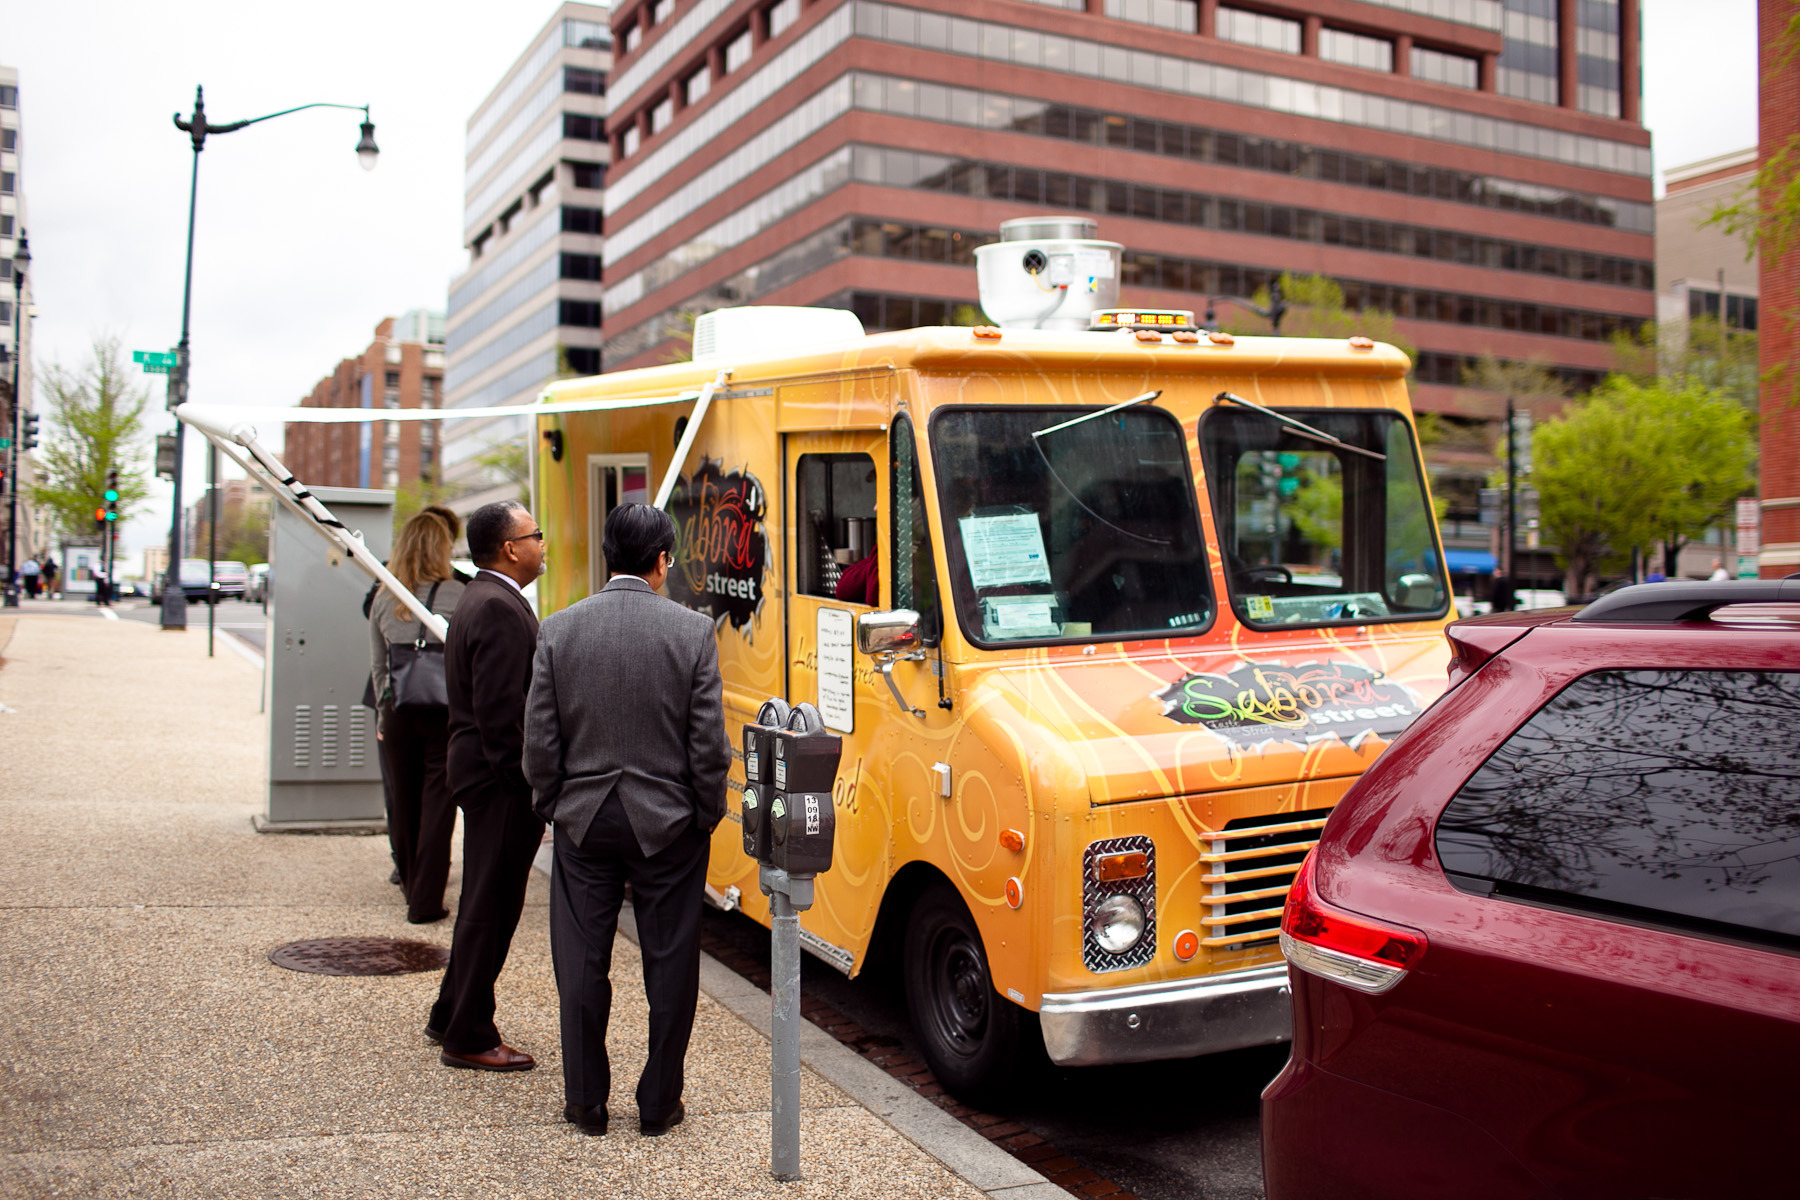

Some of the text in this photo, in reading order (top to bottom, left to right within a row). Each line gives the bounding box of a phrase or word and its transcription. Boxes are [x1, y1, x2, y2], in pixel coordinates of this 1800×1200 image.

[706, 573, 756, 600] street
[1182, 667, 1391, 730] Sabora
[1311, 703, 1412, 725] street
[806, 796, 817, 804] 13
[807, 806, 818, 814] 09
[807, 825, 819, 833] NW
